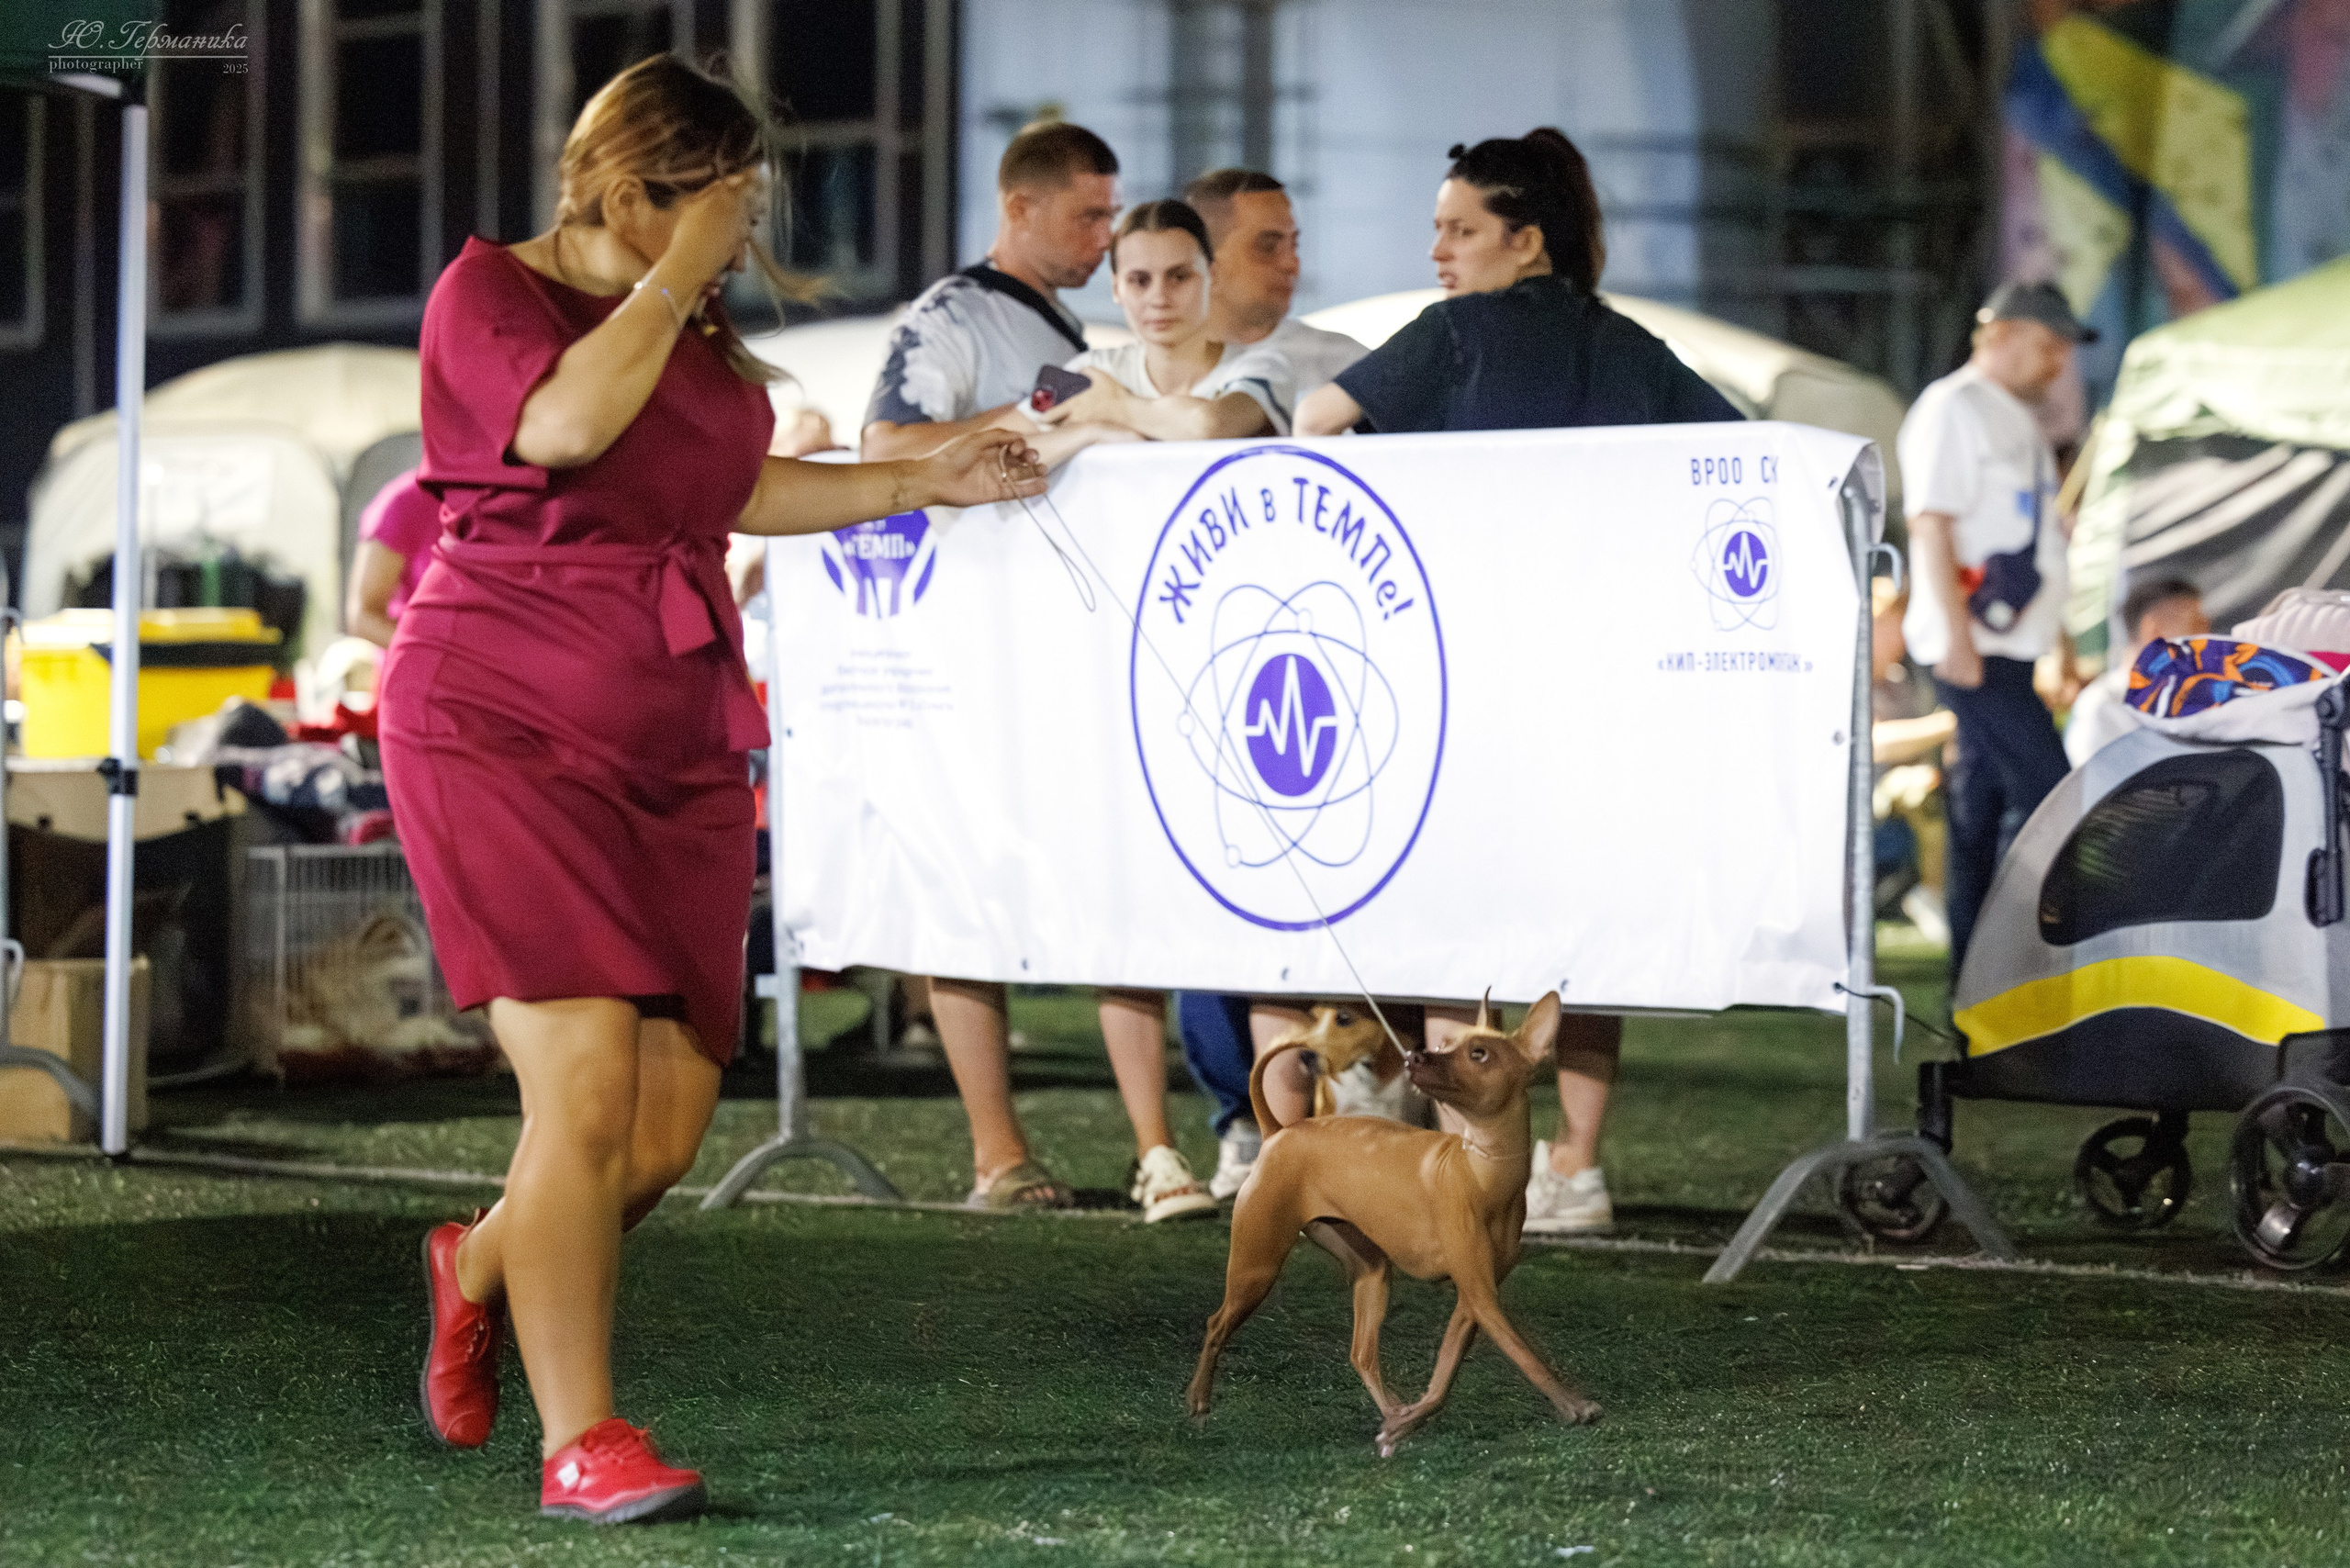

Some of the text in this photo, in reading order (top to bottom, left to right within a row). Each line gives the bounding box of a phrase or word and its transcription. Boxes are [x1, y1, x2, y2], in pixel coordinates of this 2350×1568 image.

[1690, 456, 1743, 486] ВРОО
[1158, 486, 1250, 624] ЖИВИ
[1292, 476, 1415, 622] ТЕМПе!
